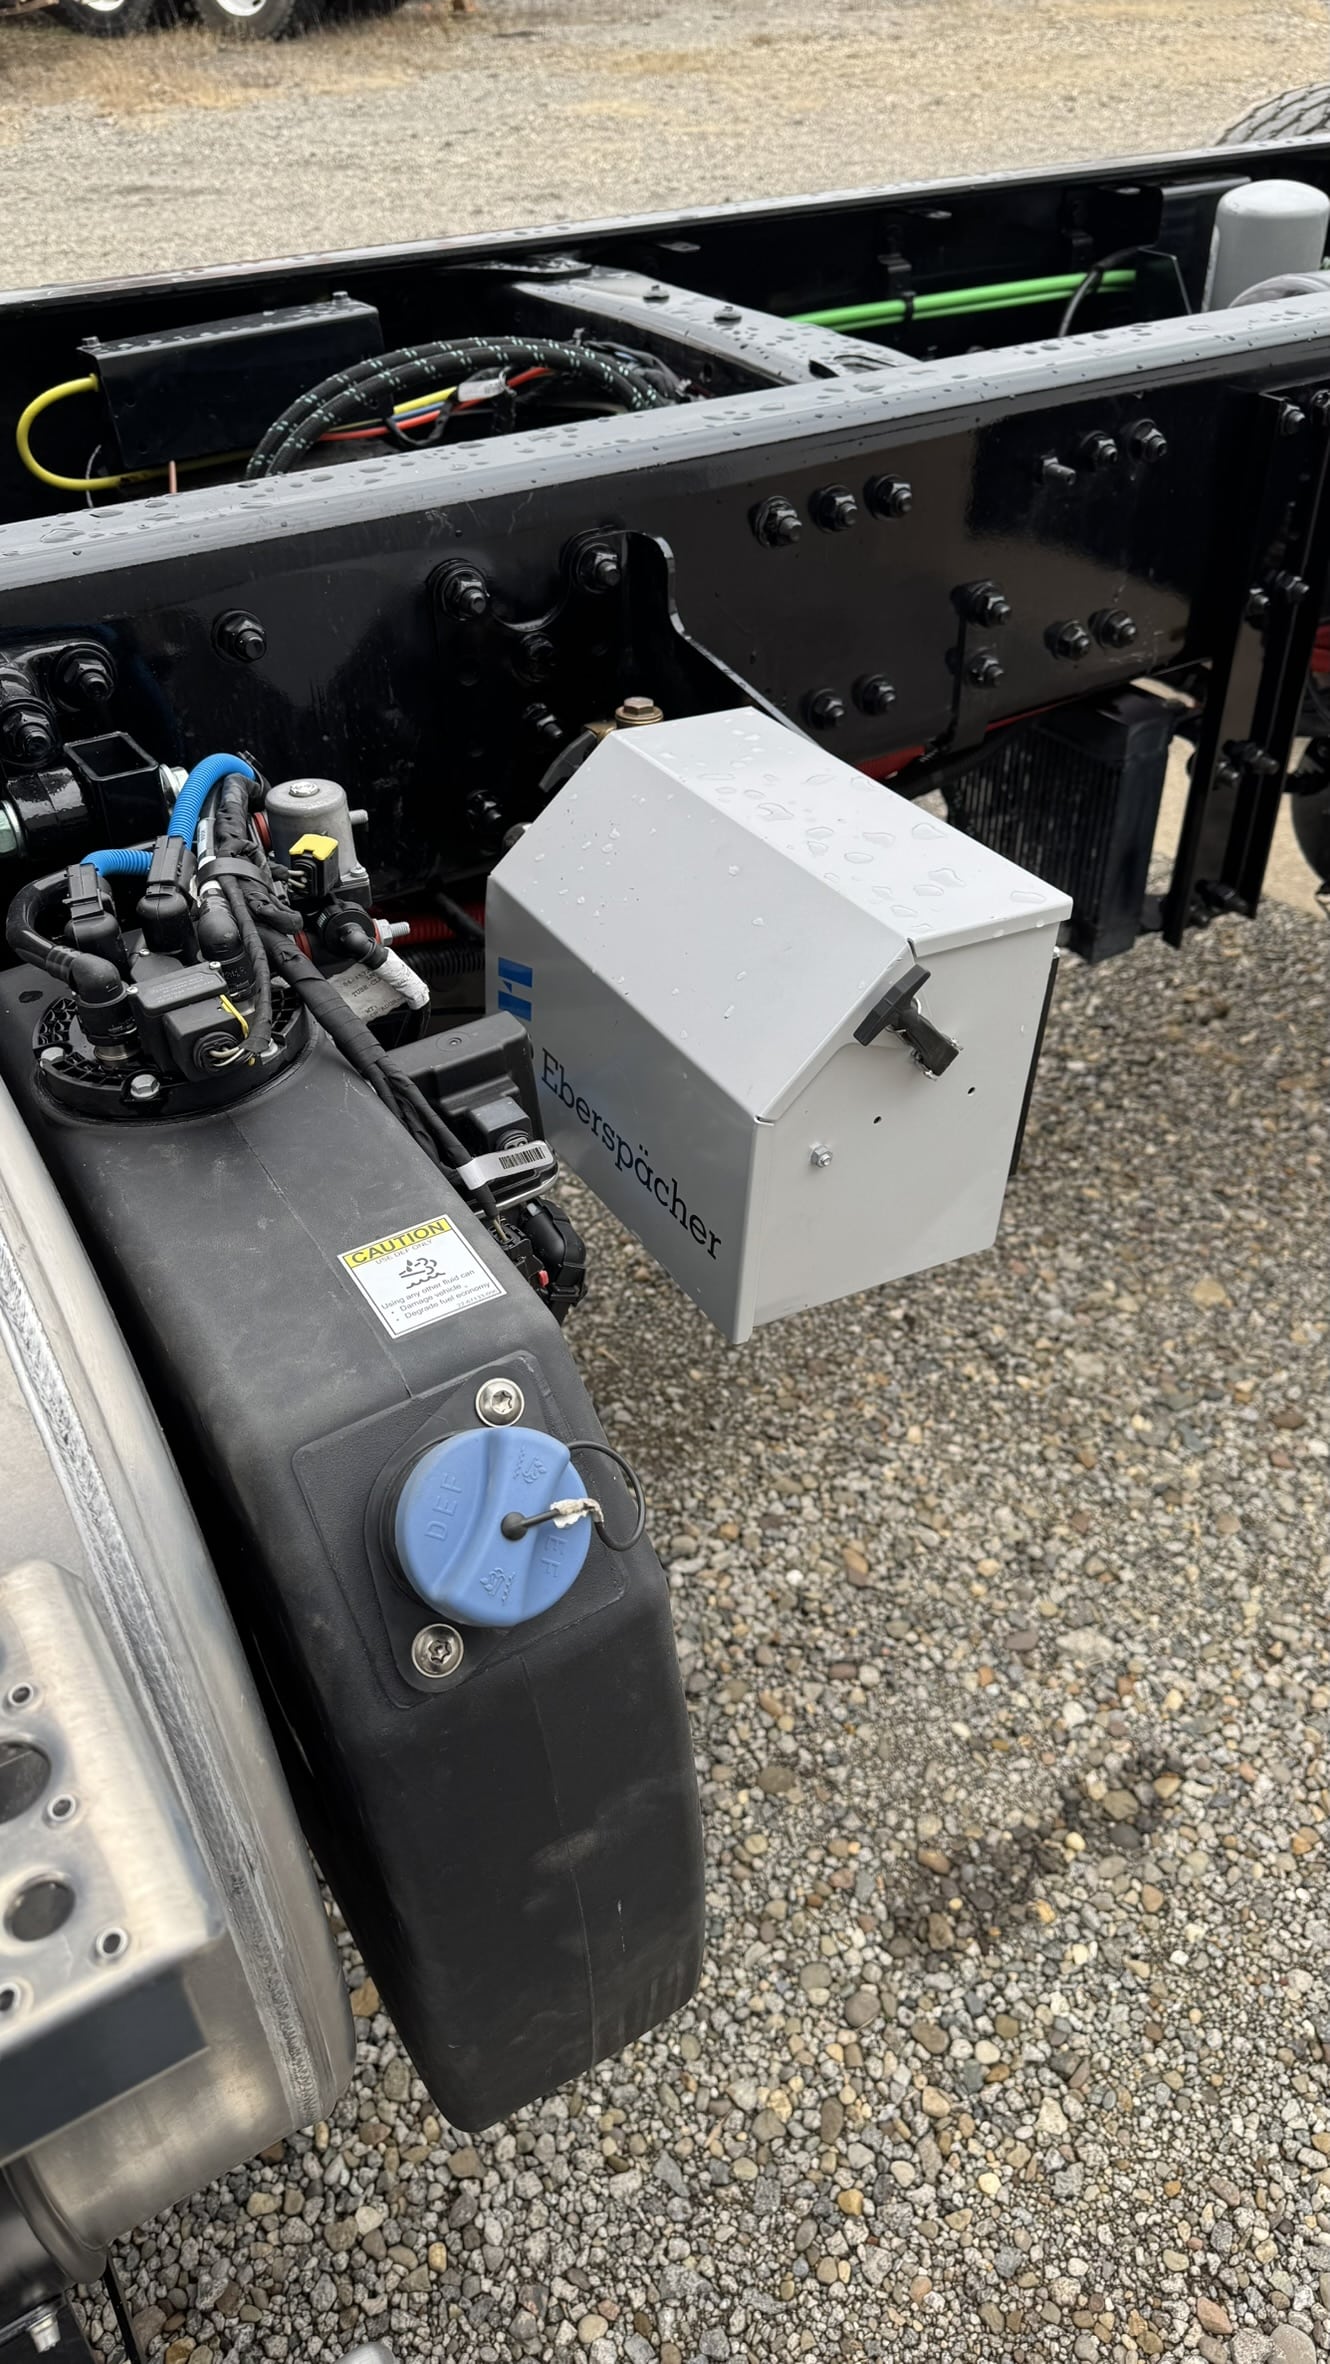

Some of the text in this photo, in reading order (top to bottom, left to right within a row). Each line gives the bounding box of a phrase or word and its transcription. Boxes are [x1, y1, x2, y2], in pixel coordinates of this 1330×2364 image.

[541, 1047, 722, 1260] Eberspächer
[351, 1221, 445, 1264] CAUTION
[375, 1239, 433, 1265] USE DEF ONLY
[381, 1269, 475, 1310] Using any other fluid can
[399, 1283, 462, 1312] Damage vehicle
[404, 1282, 491, 1319] Degrade fuel economy
[424, 1472, 462, 1543] DEF
